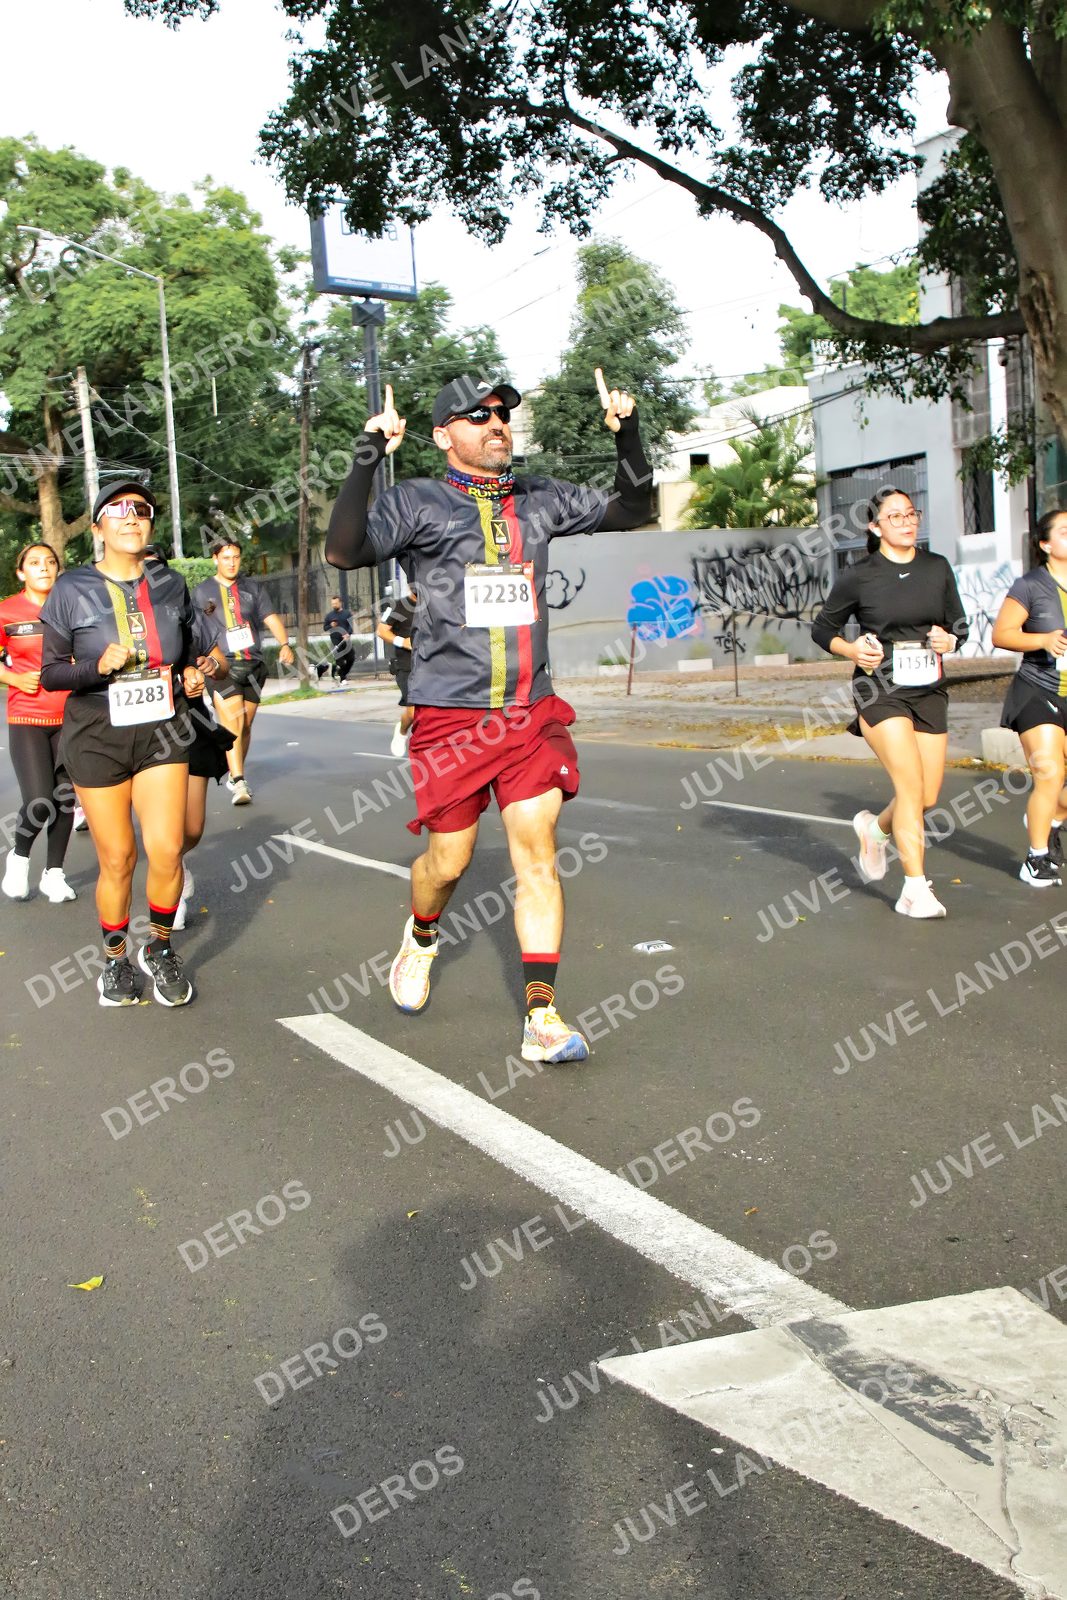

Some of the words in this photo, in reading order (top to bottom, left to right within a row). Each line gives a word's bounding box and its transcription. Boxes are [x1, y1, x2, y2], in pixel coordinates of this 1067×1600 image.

[470, 583, 529, 604] 12238
[898, 655, 936, 669] 11514
[114, 685, 165, 706] 12283
